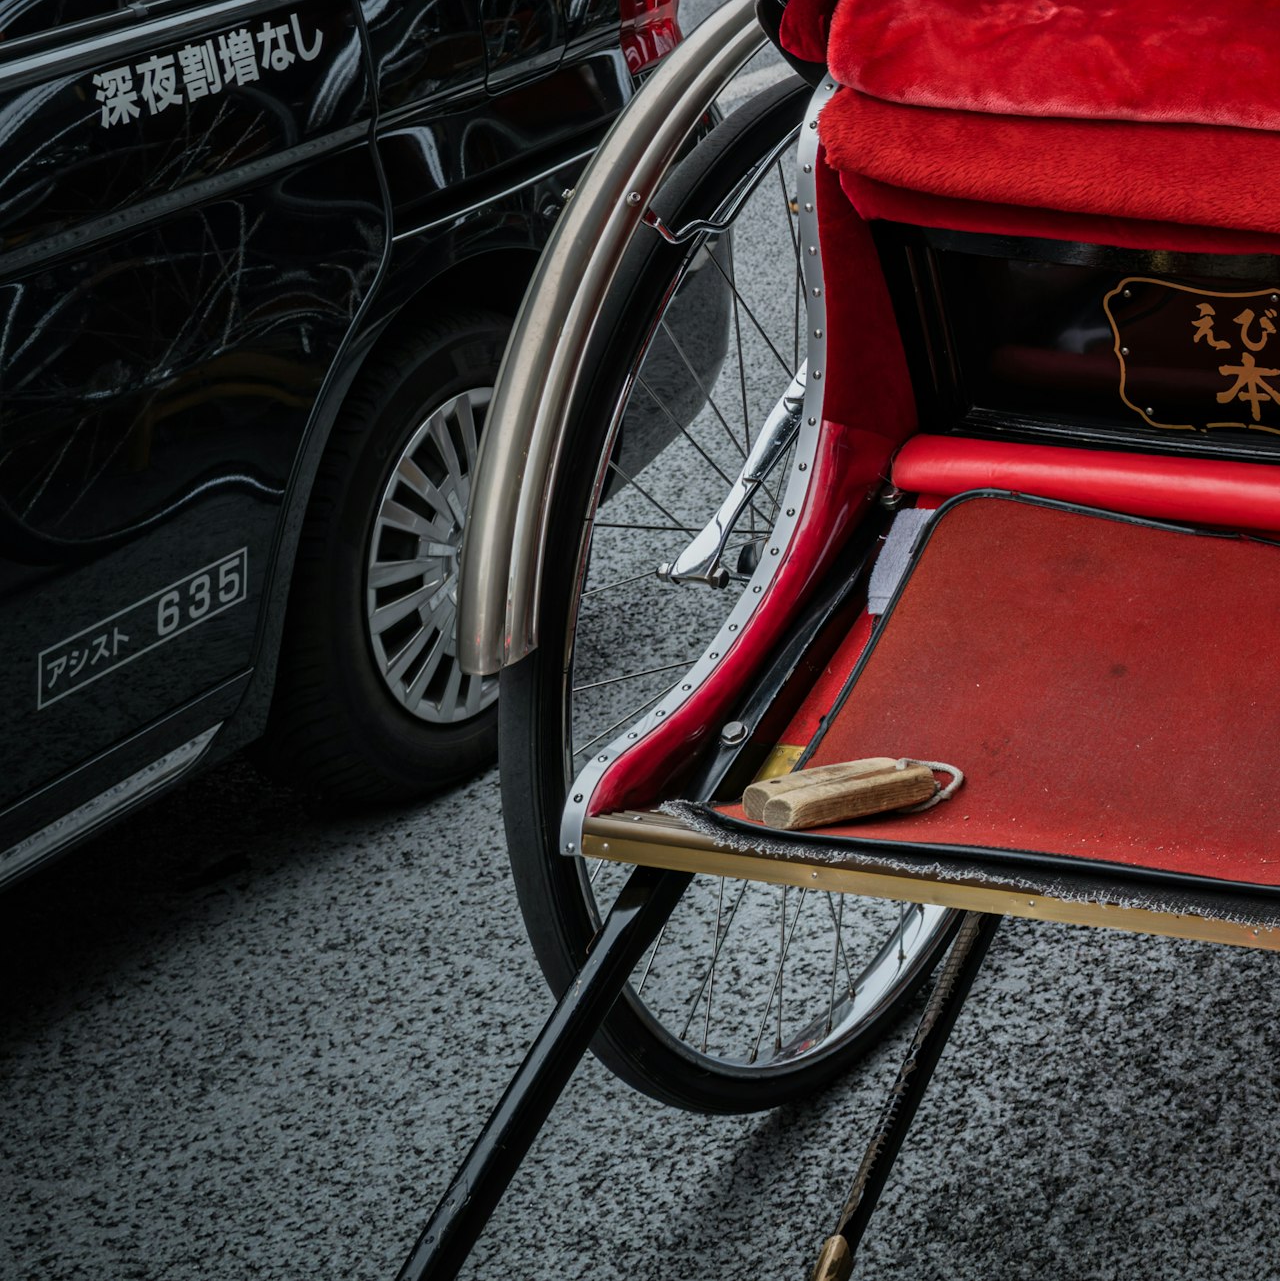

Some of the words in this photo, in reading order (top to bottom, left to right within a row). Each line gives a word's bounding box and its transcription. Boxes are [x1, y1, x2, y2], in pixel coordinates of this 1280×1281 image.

[92, 13, 324, 130] 深夜割増なし
[47, 627, 130, 689] アシスト
[157, 557, 241, 637] 635
